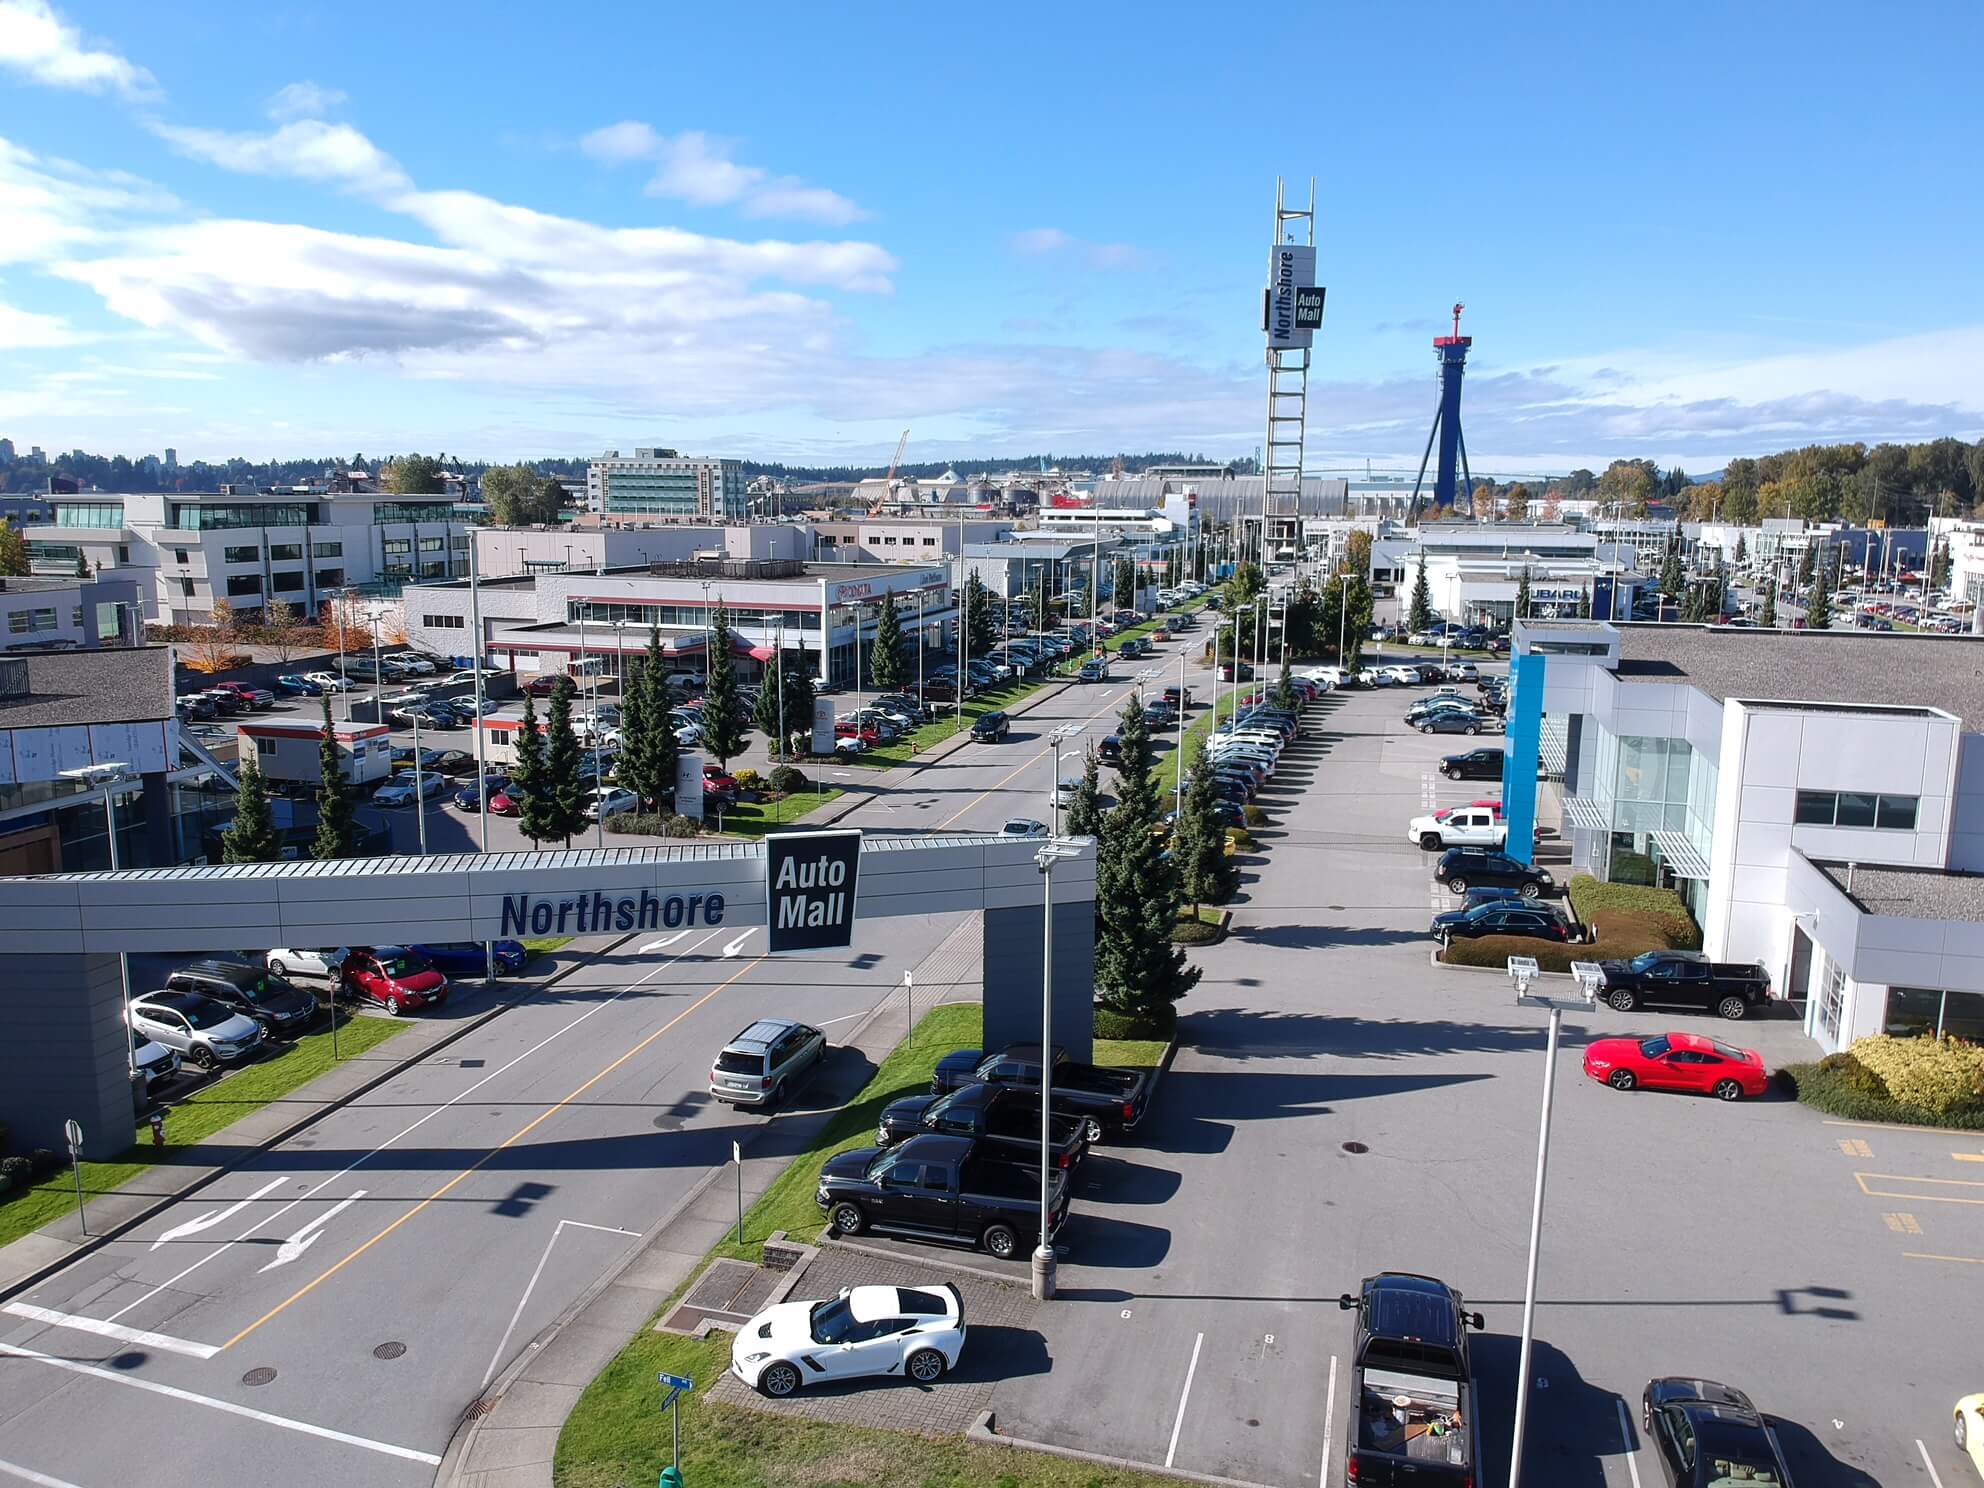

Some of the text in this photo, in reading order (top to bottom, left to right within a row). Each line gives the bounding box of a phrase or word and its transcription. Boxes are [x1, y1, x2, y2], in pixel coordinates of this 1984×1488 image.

[1274, 251, 1294, 340] Northshore
[1298, 293, 1321, 308] Auto
[1297, 307, 1320, 322] Mall
[1530, 588, 1582, 599] UBARU
[776, 855, 846, 890] Auto
[500, 889, 725, 937] Northshore
[777, 892, 845, 929] Mall
[1264, 1334, 1275, 1344] 8
[659, 1373, 671, 1385] Fell
